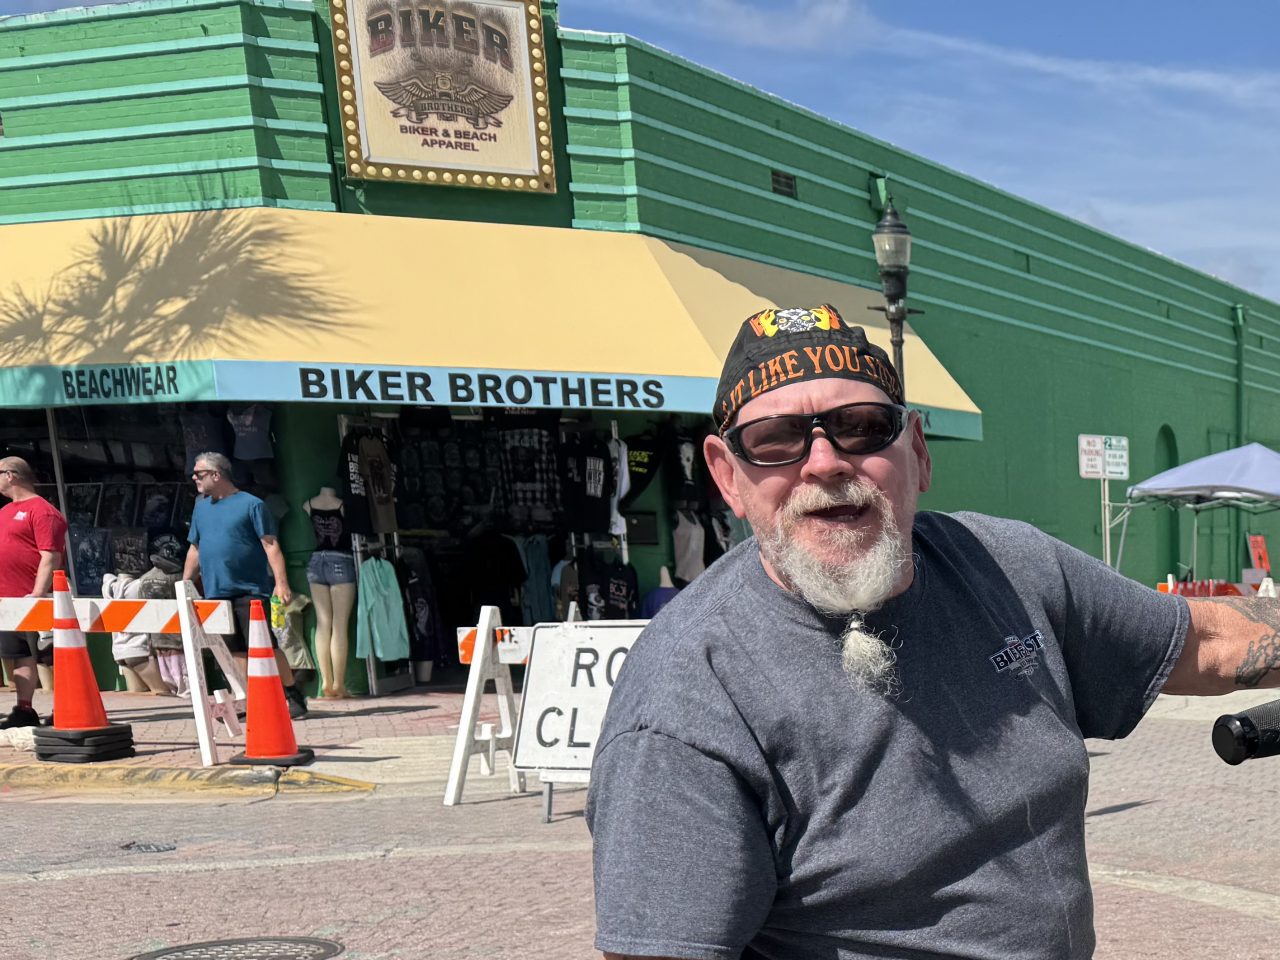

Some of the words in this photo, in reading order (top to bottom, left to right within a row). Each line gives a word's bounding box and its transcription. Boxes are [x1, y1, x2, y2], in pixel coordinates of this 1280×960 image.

[367, 7, 515, 73] BIKER
[420, 102, 473, 116] BROTHERS
[400, 125, 438, 137] BIKER
[441, 127, 451, 137] &
[454, 129, 497, 142] BEACH
[421, 138, 479, 152] APPAREL
[62, 365, 179, 399] BEACHWEAR
[299, 367, 435, 402] BIKER
[448, 372, 665, 409] BROTHERS
[747, 350, 804, 398] LIKE
[803, 344, 861, 374] YOU
